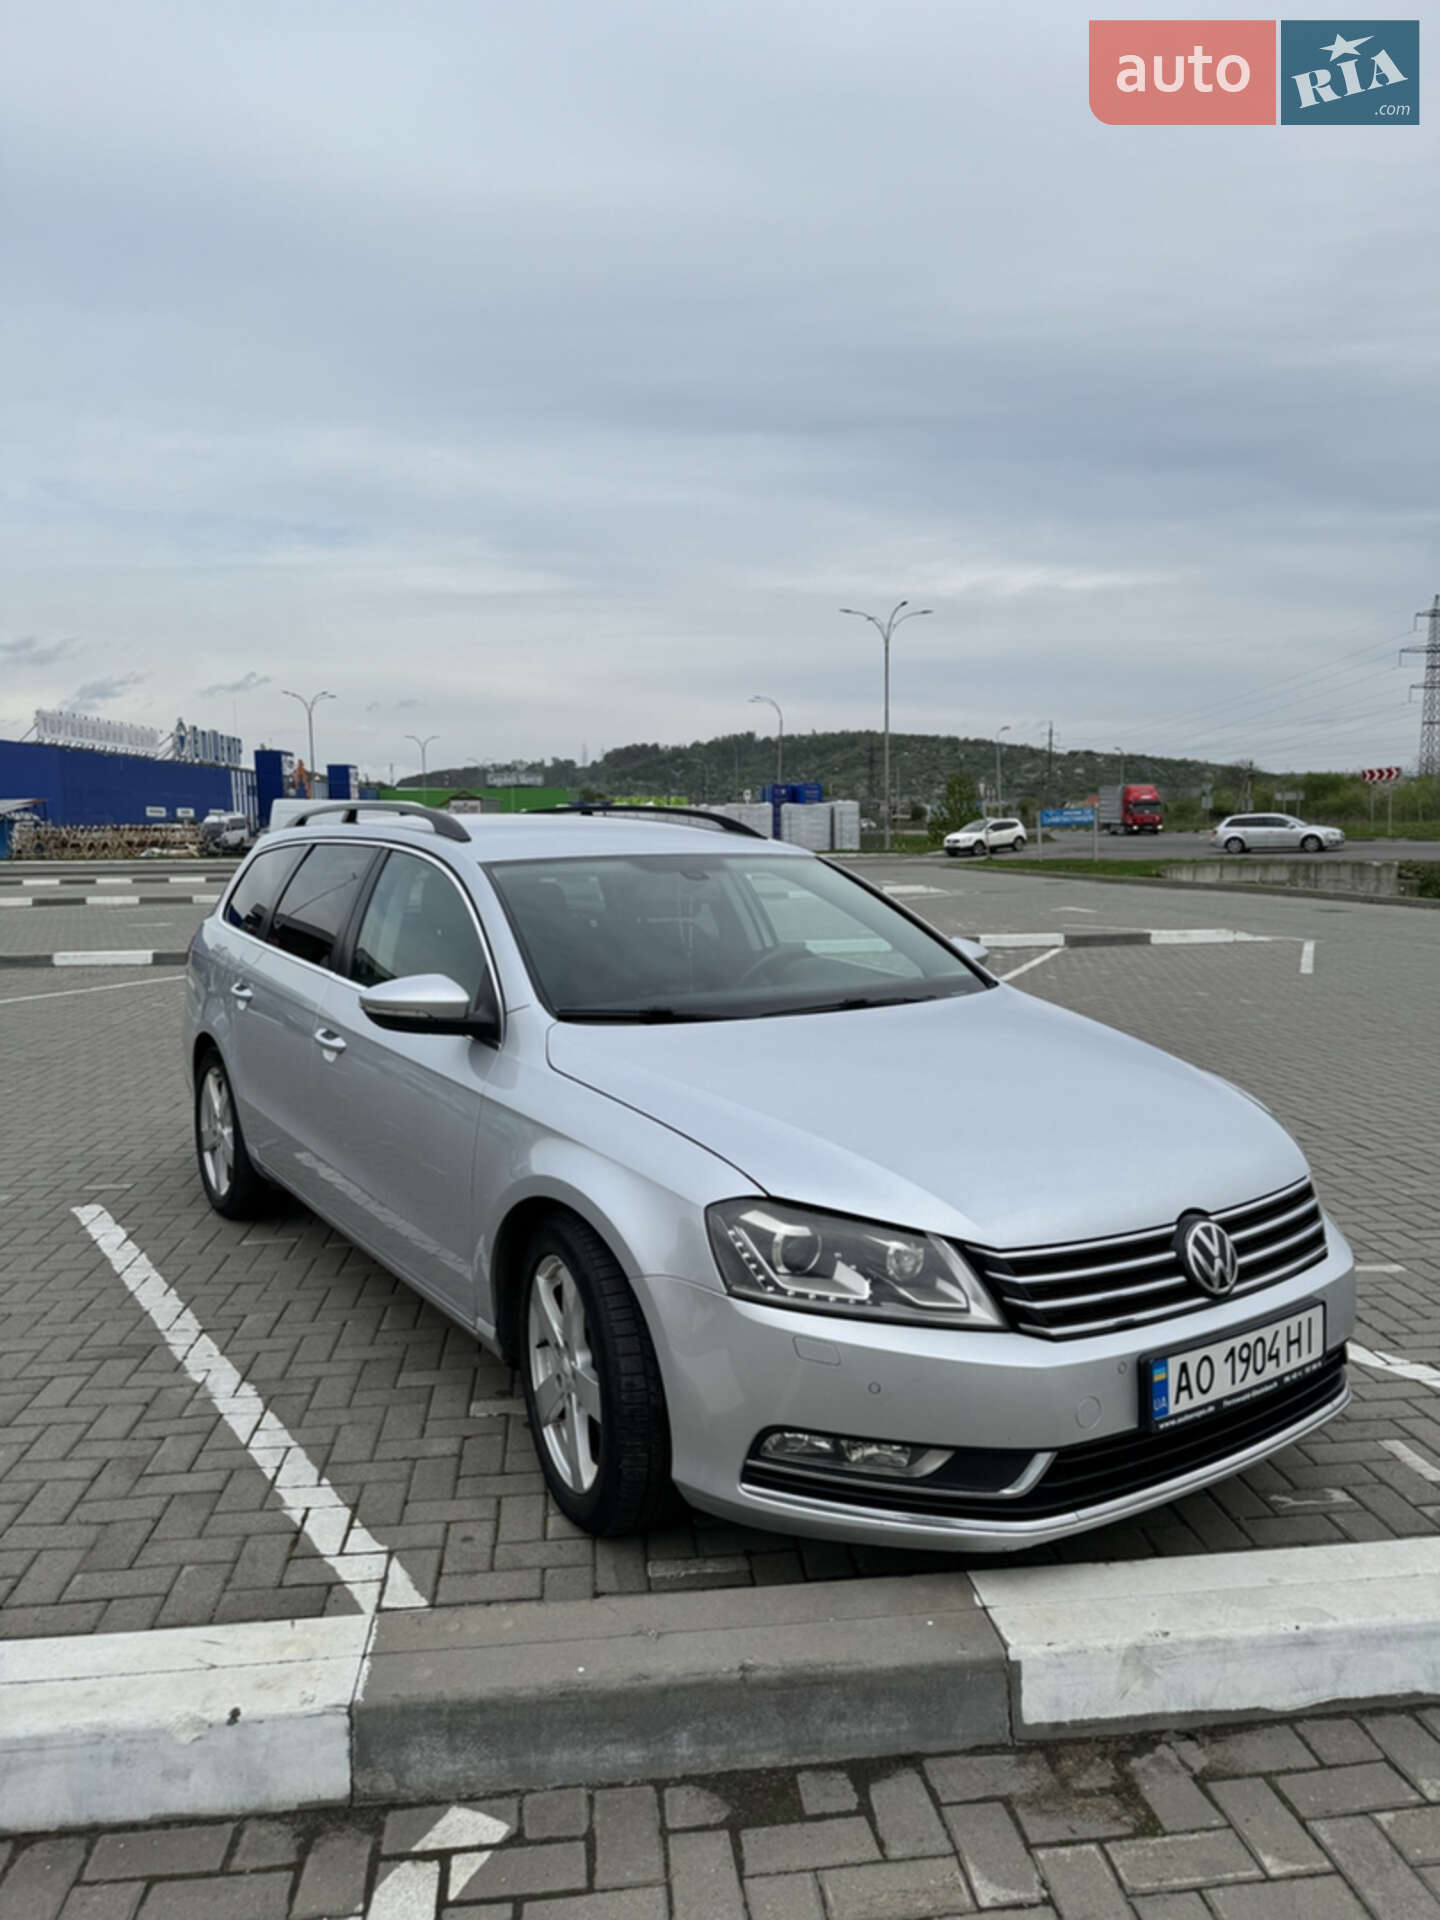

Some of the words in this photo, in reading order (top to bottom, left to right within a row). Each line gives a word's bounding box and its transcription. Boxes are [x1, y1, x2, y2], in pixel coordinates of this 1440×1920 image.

[1174, 1354, 1215, 1405] AO
[1224, 1329, 1281, 1386] 1904
[1286, 1317, 1312, 1364] HI
